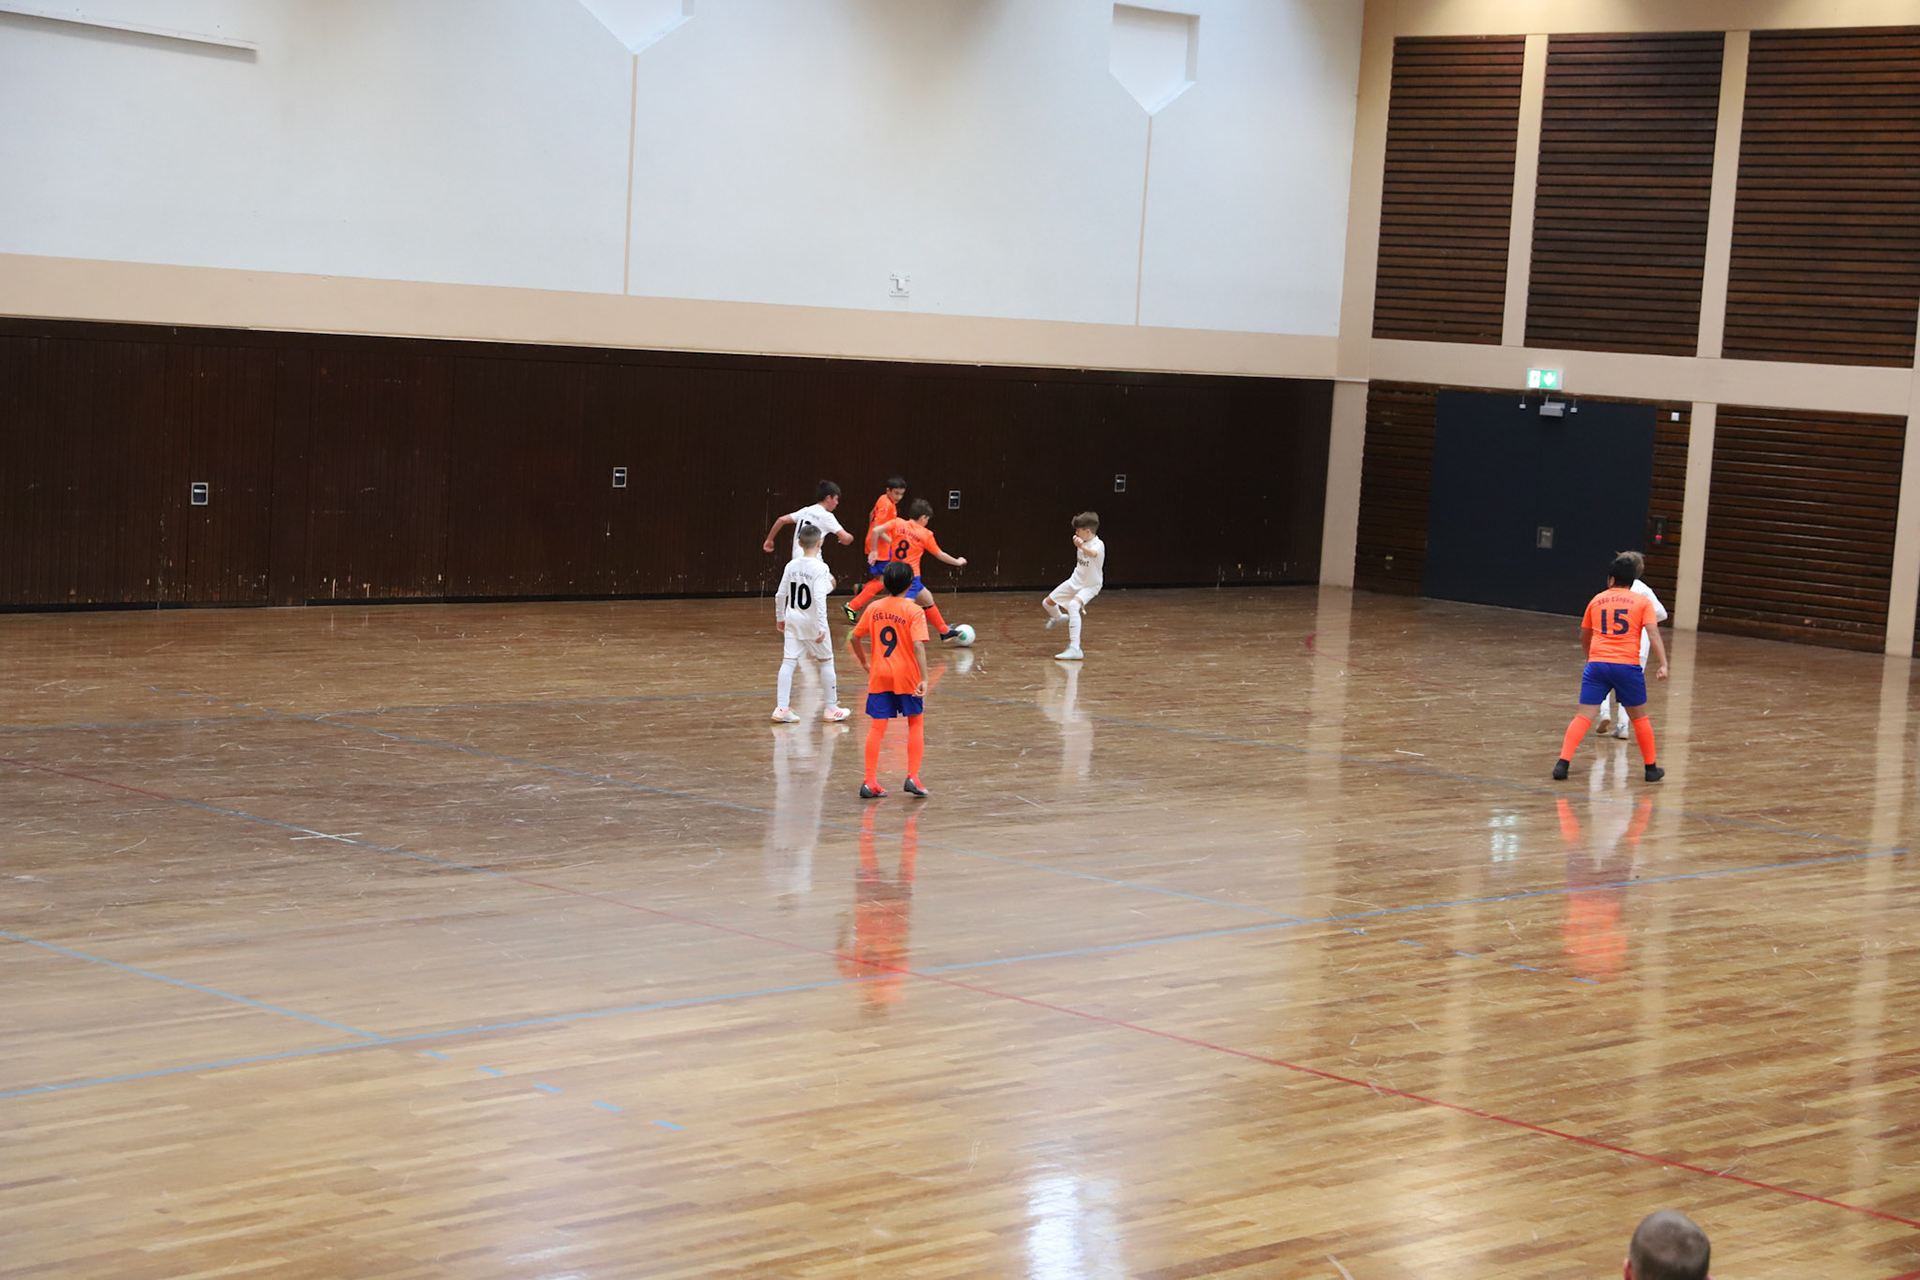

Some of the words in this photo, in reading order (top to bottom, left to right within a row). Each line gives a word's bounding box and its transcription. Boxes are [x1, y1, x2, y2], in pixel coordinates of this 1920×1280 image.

[895, 540, 909, 560] 8
[790, 582, 812, 610] 10
[1601, 609, 1630, 635] 15
[880, 626, 897, 658] 9
